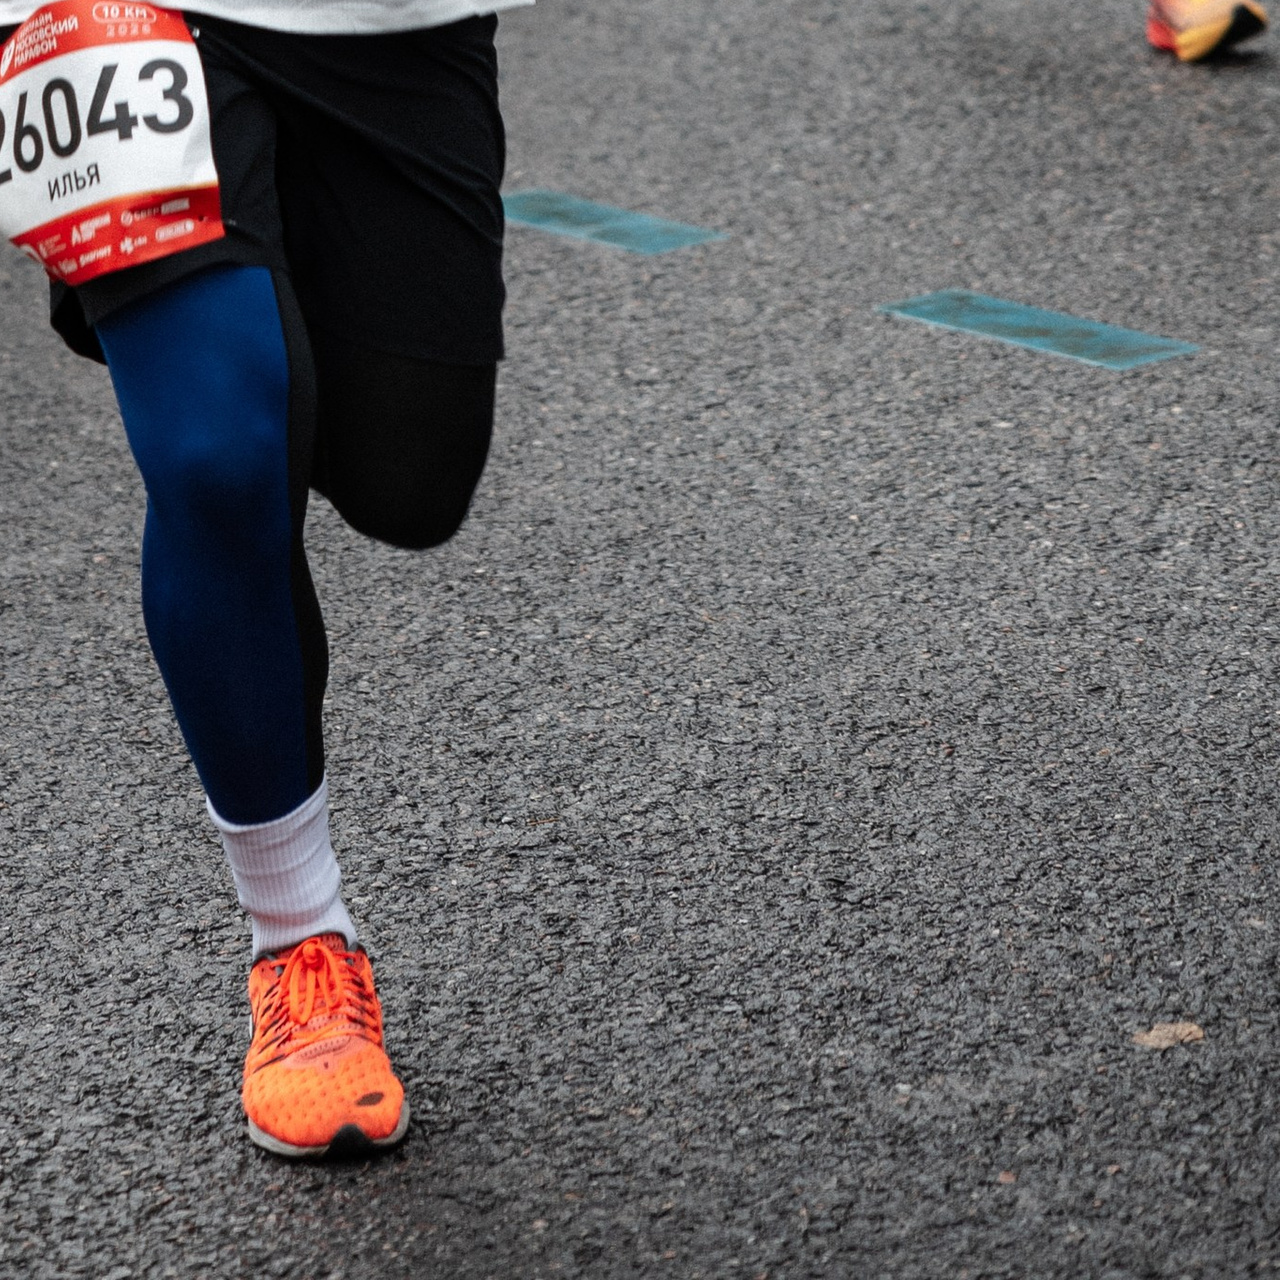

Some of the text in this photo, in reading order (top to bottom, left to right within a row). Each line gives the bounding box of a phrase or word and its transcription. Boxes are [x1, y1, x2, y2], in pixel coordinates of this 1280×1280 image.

[102, 4, 147, 20] 10 КМ
[47, 162, 101, 203] ИЛЬЯ
